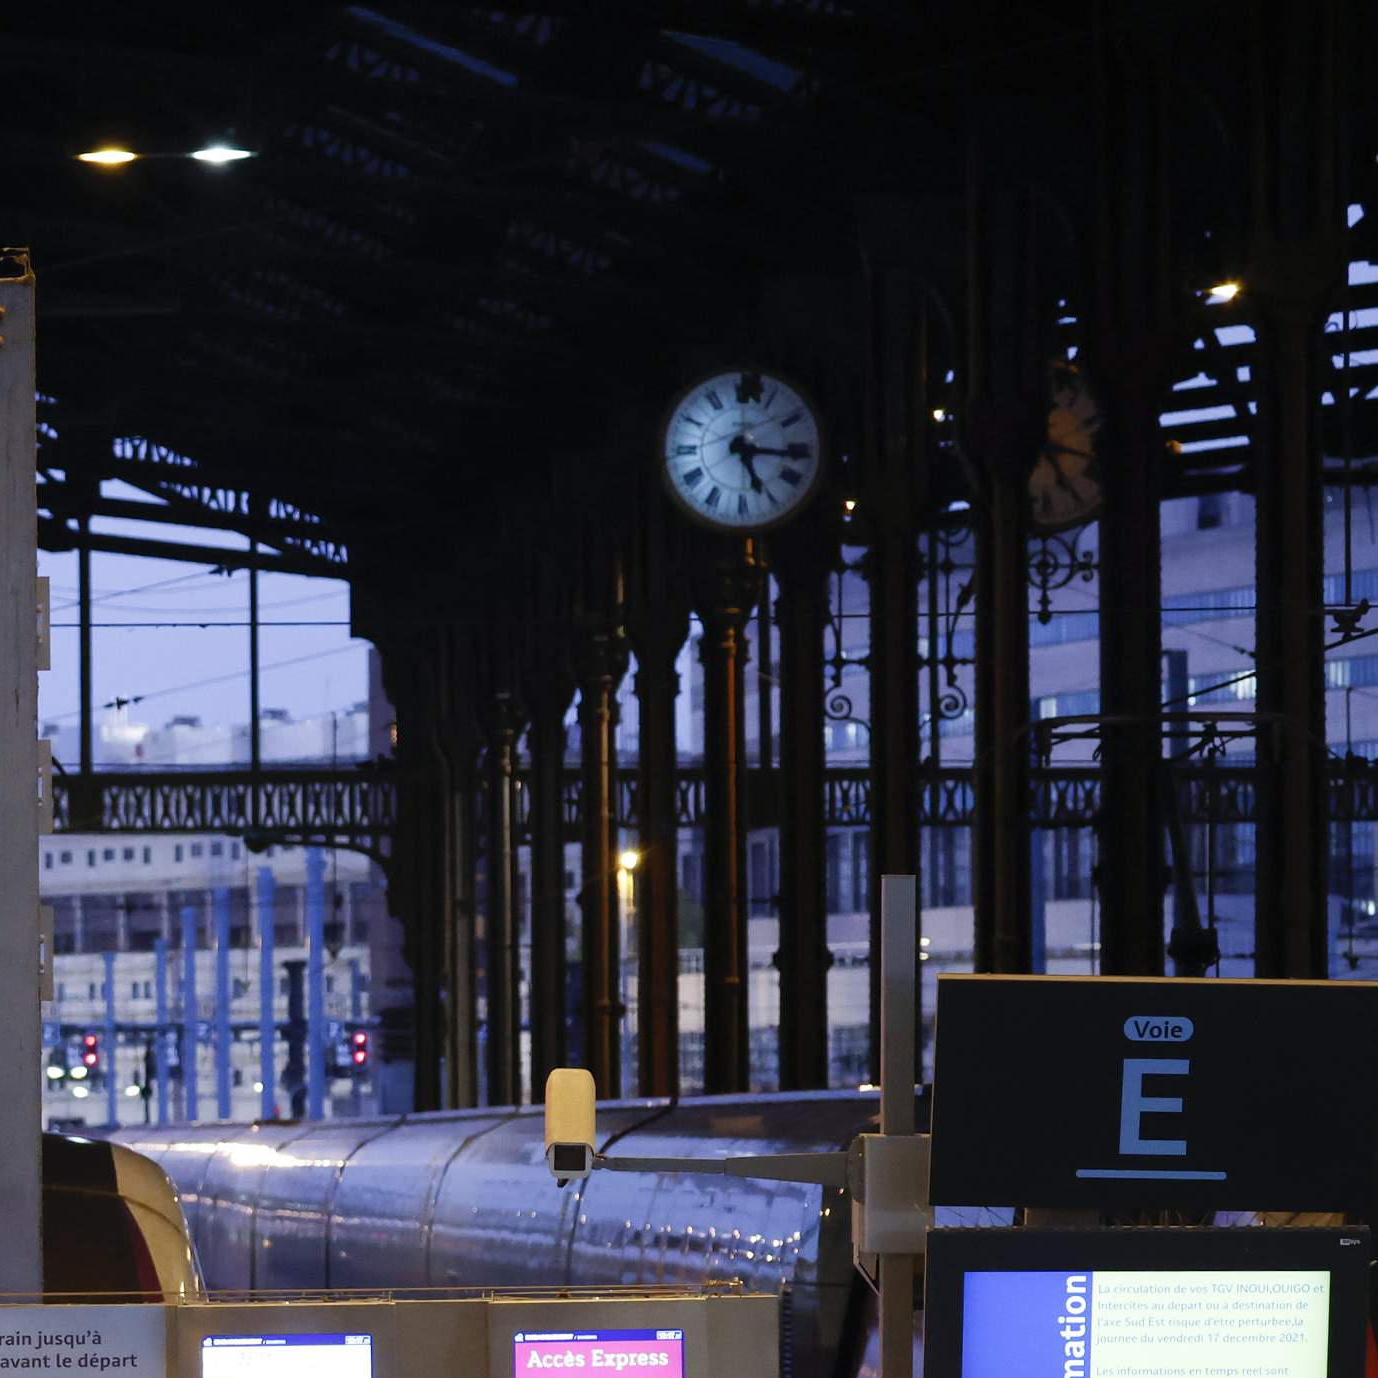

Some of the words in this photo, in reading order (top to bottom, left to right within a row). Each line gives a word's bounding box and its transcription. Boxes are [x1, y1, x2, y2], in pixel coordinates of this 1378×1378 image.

[1134, 1019, 1184, 1041] Voie
[1119, 1059, 1190, 1156] E
[1098, 1285, 1110, 1293] La
[1114, 1284, 1171, 1293] circulation
[1174, 1284, 1187, 1293] de
[1211, 1284, 1233, 1293] TGV
[1314, 1285, 1324, 1293] et
[1098, 1301, 1148, 1310] Intercites
[1168, 1301, 1202, 1312] depart
[1232, 1301, 1292, 1310] destination
[1295, 1301, 1309, 1310] de
[1097, 1317, 1121, 1326] l'axe
[1125, 1317, 1145, 1326] Sud
[1148, 1317, 1165, 1326] Est
[1168, 1317, 1201, 1329] risque
[1204, 1317, 1235, 1326] d'etre
[1095, 1334, 1138, 1345] journee
[1140, 1333, 1154, 1343] du
[1157, 1333, 1204, 1343] vendredi
[1207, 1334, 1220, 1342] 17
[1223, 1333, 1276, 1343] decembre
[1279, 1333, 1308, 1343] 2021.
[1, 1354, 50, 1368] avant
[56, 1354, 72, 1368] le
[78, 1353, 138, 1371] départ
[527, 1350, 585, 1368] Accès
[591, 1349, 669, 1371] Express
[1096, 1367, 1114, 1376] Les
[1117, 1366, 1186, 1376] informations
[1189, 1368, 1202, 1376] en
[1205, 1367, 1239, 1378] temps
[1242, 1366, 1262, 1375] reel
[1265, 1367, 1289, 1375] sont
